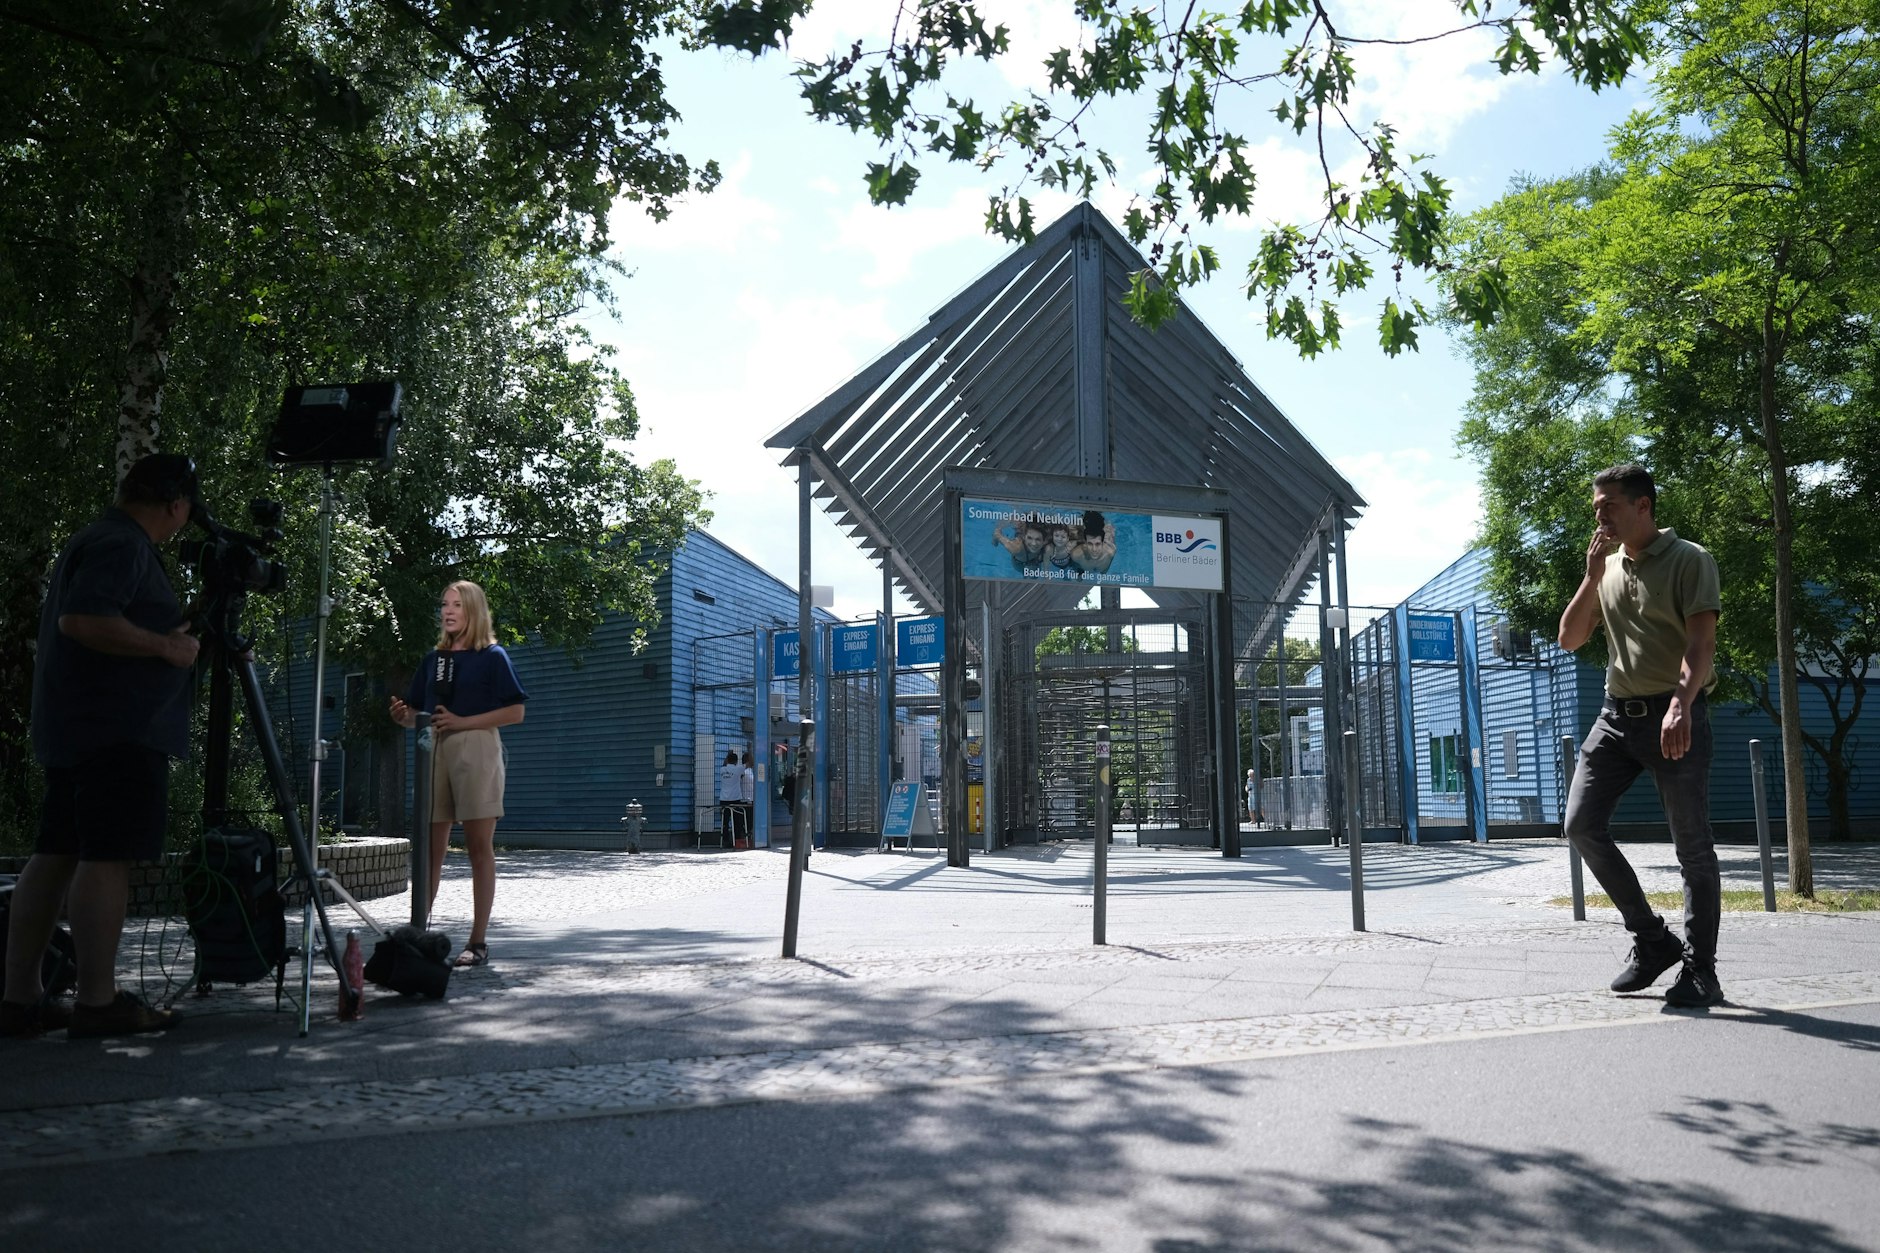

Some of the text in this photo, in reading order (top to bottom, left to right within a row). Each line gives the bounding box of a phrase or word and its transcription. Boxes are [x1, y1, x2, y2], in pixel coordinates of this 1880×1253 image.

[968, 507, 1084, 526] Sommerbad Neukölln
[1156, 532, 1182, 544] BBB
[1156, 553, 1217, 566] Berliner Bäder
[1023, 567, 1065, 581] Badespaß
[1066, 569, 1079, 580] für
[1081, 570, 1095, 580] die
[1096, 573, 1121, 584] ganze
[908, 623, 938, 635] EXPRESS-
[1411, 629, 1447, 641] ROLLSTÜHLE
[843, 630, 870, 641] EXPRESS-
[909, 633, 936, 645] EINGANG
[843, 640, 868, 651] EINGANG
